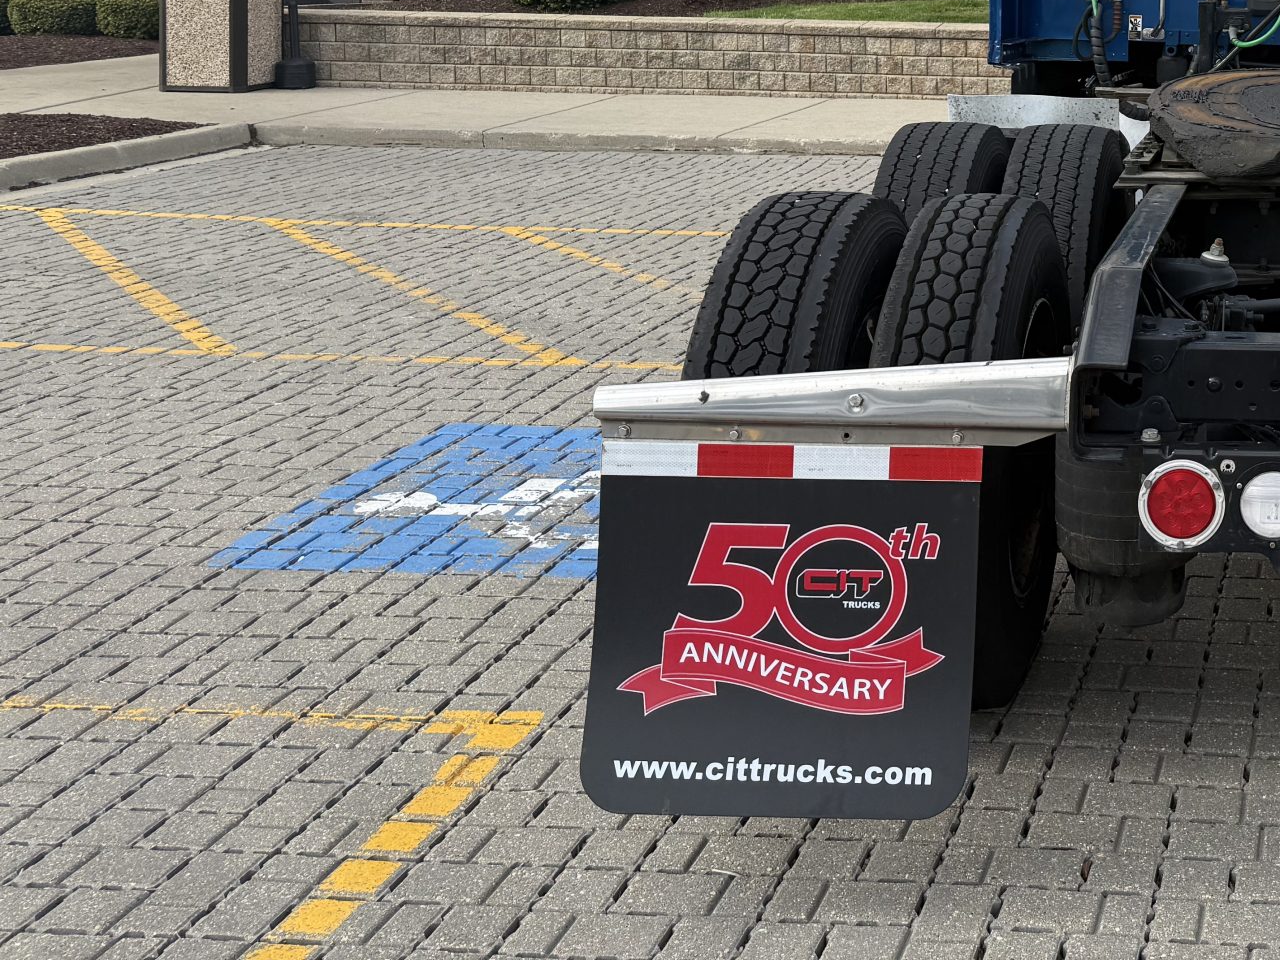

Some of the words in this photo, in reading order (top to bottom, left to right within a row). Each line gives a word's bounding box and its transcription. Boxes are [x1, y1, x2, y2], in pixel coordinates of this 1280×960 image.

[796, 568, 884, 599] CIT
[842, 601, 881, 609] TRUCKS
[679, 642, 893, 700] ANNIVERSARY
[613, 756, 933, 785] www.cittrucks.com
